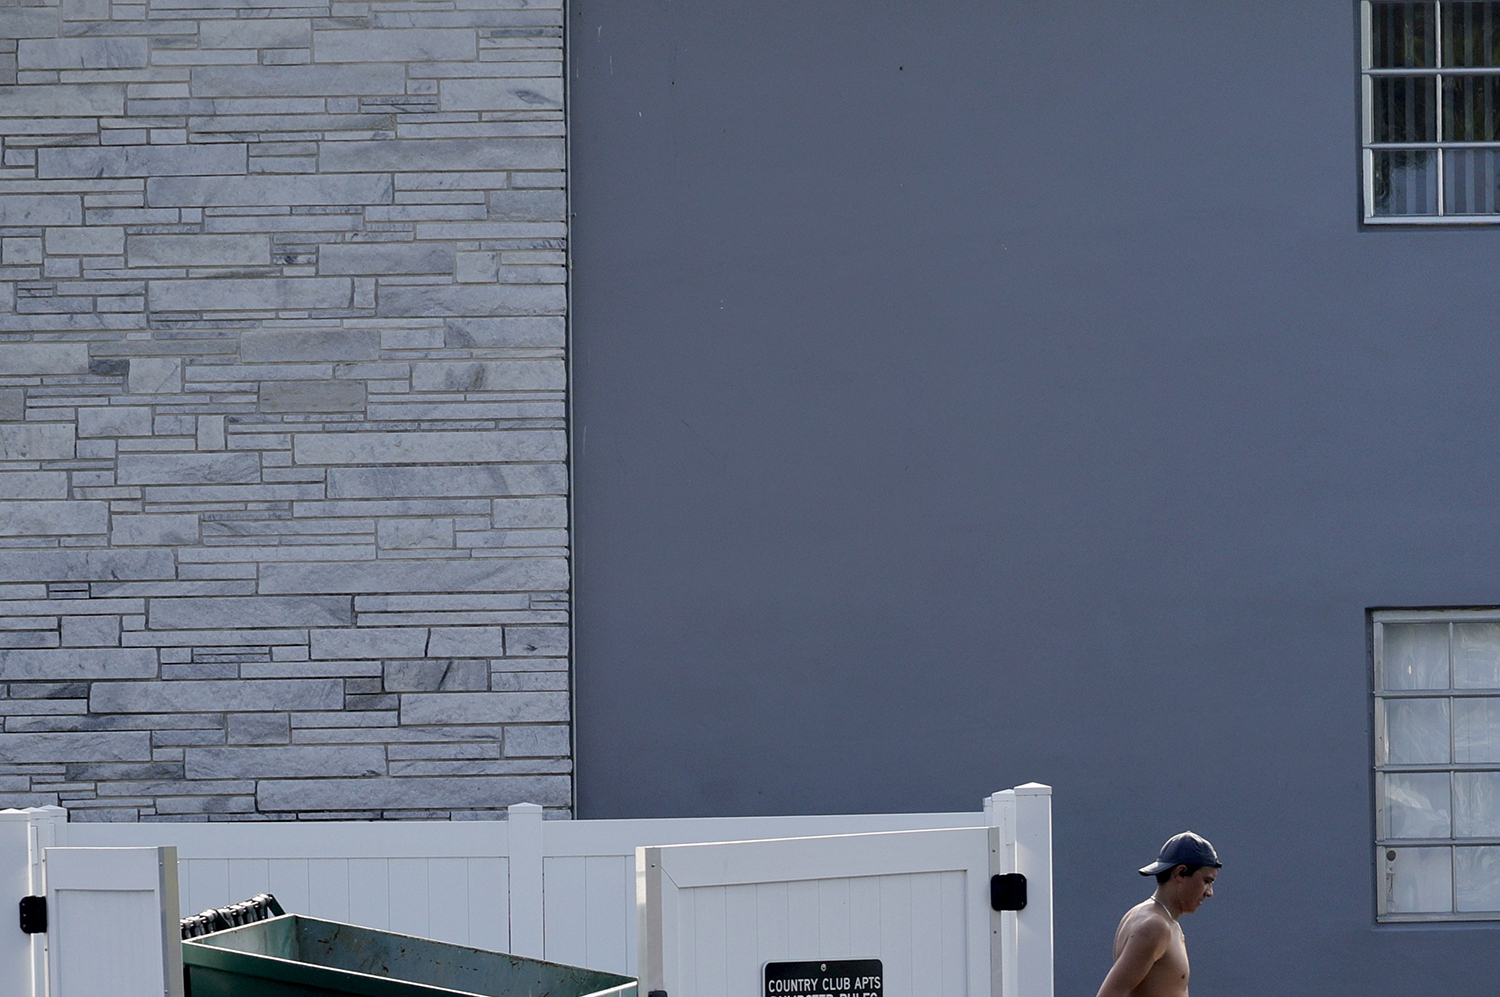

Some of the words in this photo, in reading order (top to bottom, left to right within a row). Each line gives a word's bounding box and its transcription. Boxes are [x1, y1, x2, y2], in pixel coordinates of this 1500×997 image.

[768, 978, 819, 993] COUNTRY
[822, 977, 851, 991] CLUB
[854, 976, 881, 990] APTS
